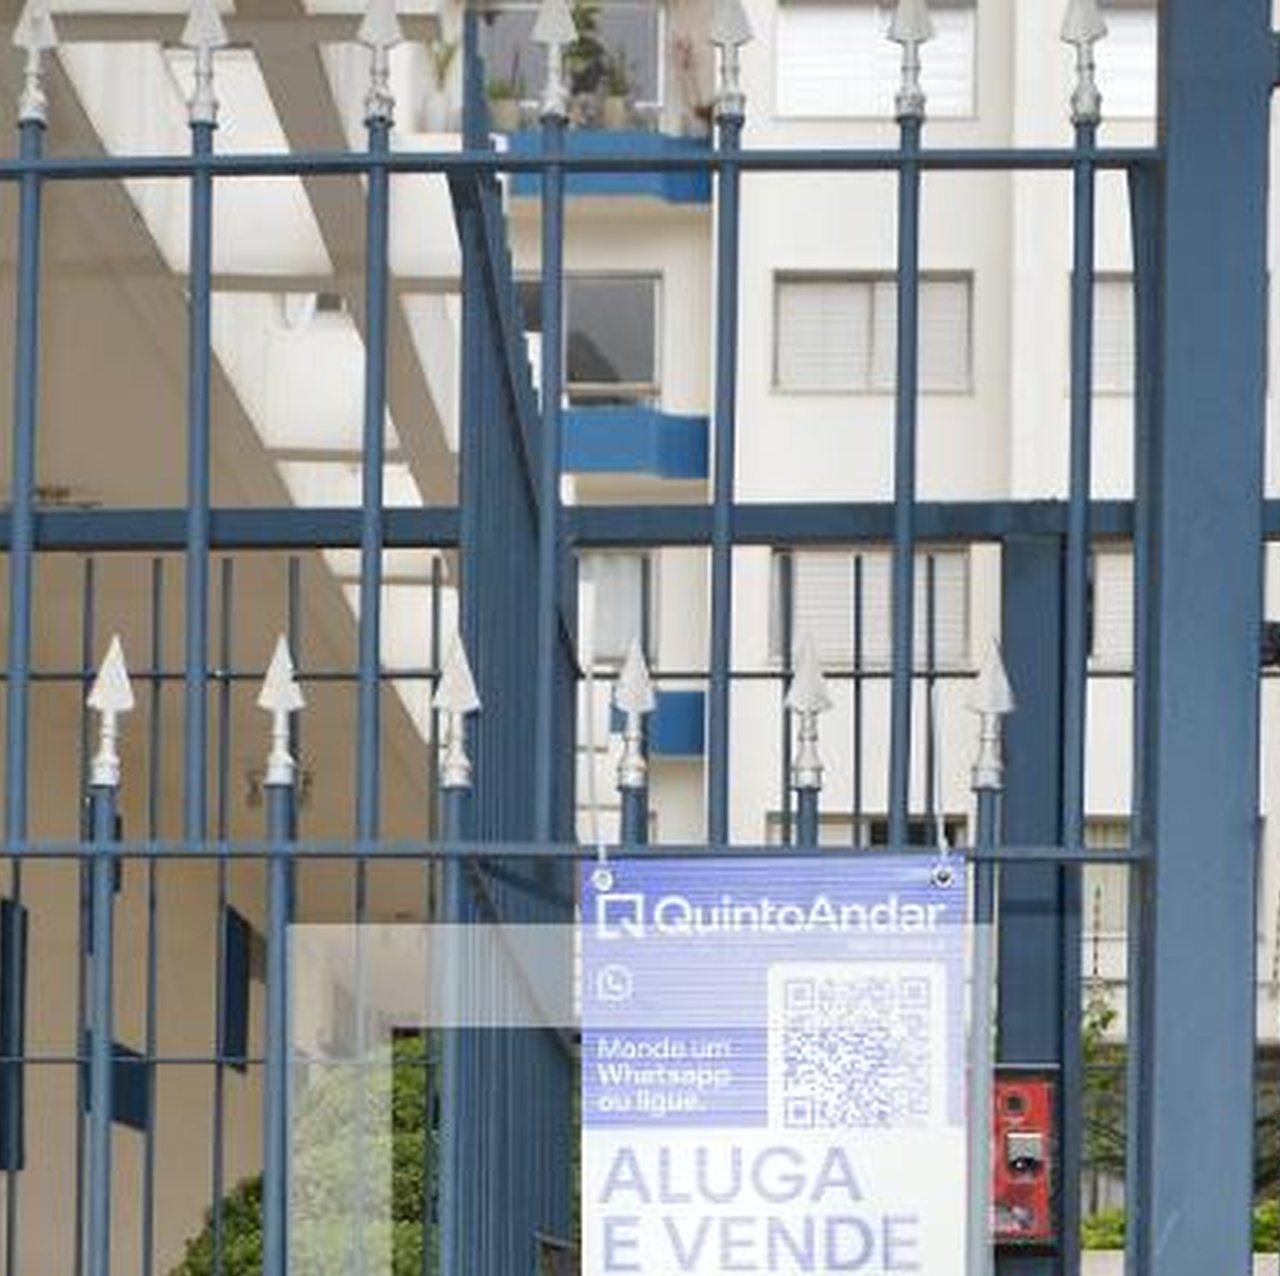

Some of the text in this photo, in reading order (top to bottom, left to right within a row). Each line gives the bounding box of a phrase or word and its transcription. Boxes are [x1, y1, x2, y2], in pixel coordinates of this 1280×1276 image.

[654, 894, 947, 937] QuintoAndar
[690, 1041, 733, 1058] um
[599, 1095, 631, 1112] ou
[599, 1146, 864, 1203] ALUGA
[602, 1215, 922, 1272] E VENDE
